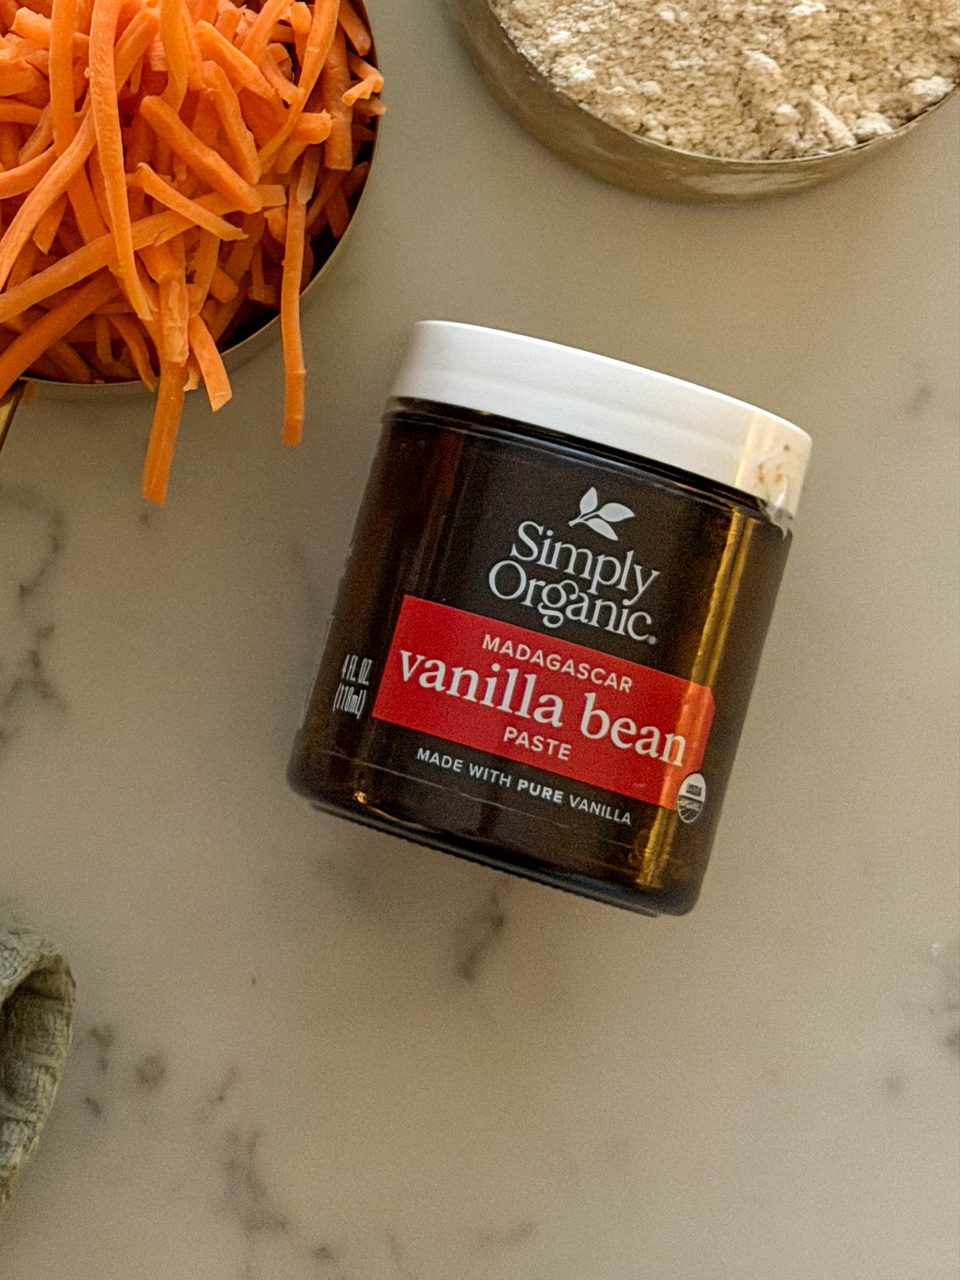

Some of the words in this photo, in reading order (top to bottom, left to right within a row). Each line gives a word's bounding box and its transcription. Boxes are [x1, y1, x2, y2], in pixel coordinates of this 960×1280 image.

[510, 520, 662, 606] Simply
[482, 633, 634, 694] MADAGASCAR
[400, 649, 564, 728] vanilla
[580, 692, 687, 767] bean
[503, 726, 573, 761] PASTE
[416, 747, 464, 773] MADE
[469, 763, 513, 788] WITH
[517, 779, 565, 804] PURE
[569, 794, 633, 827] VANILLA
